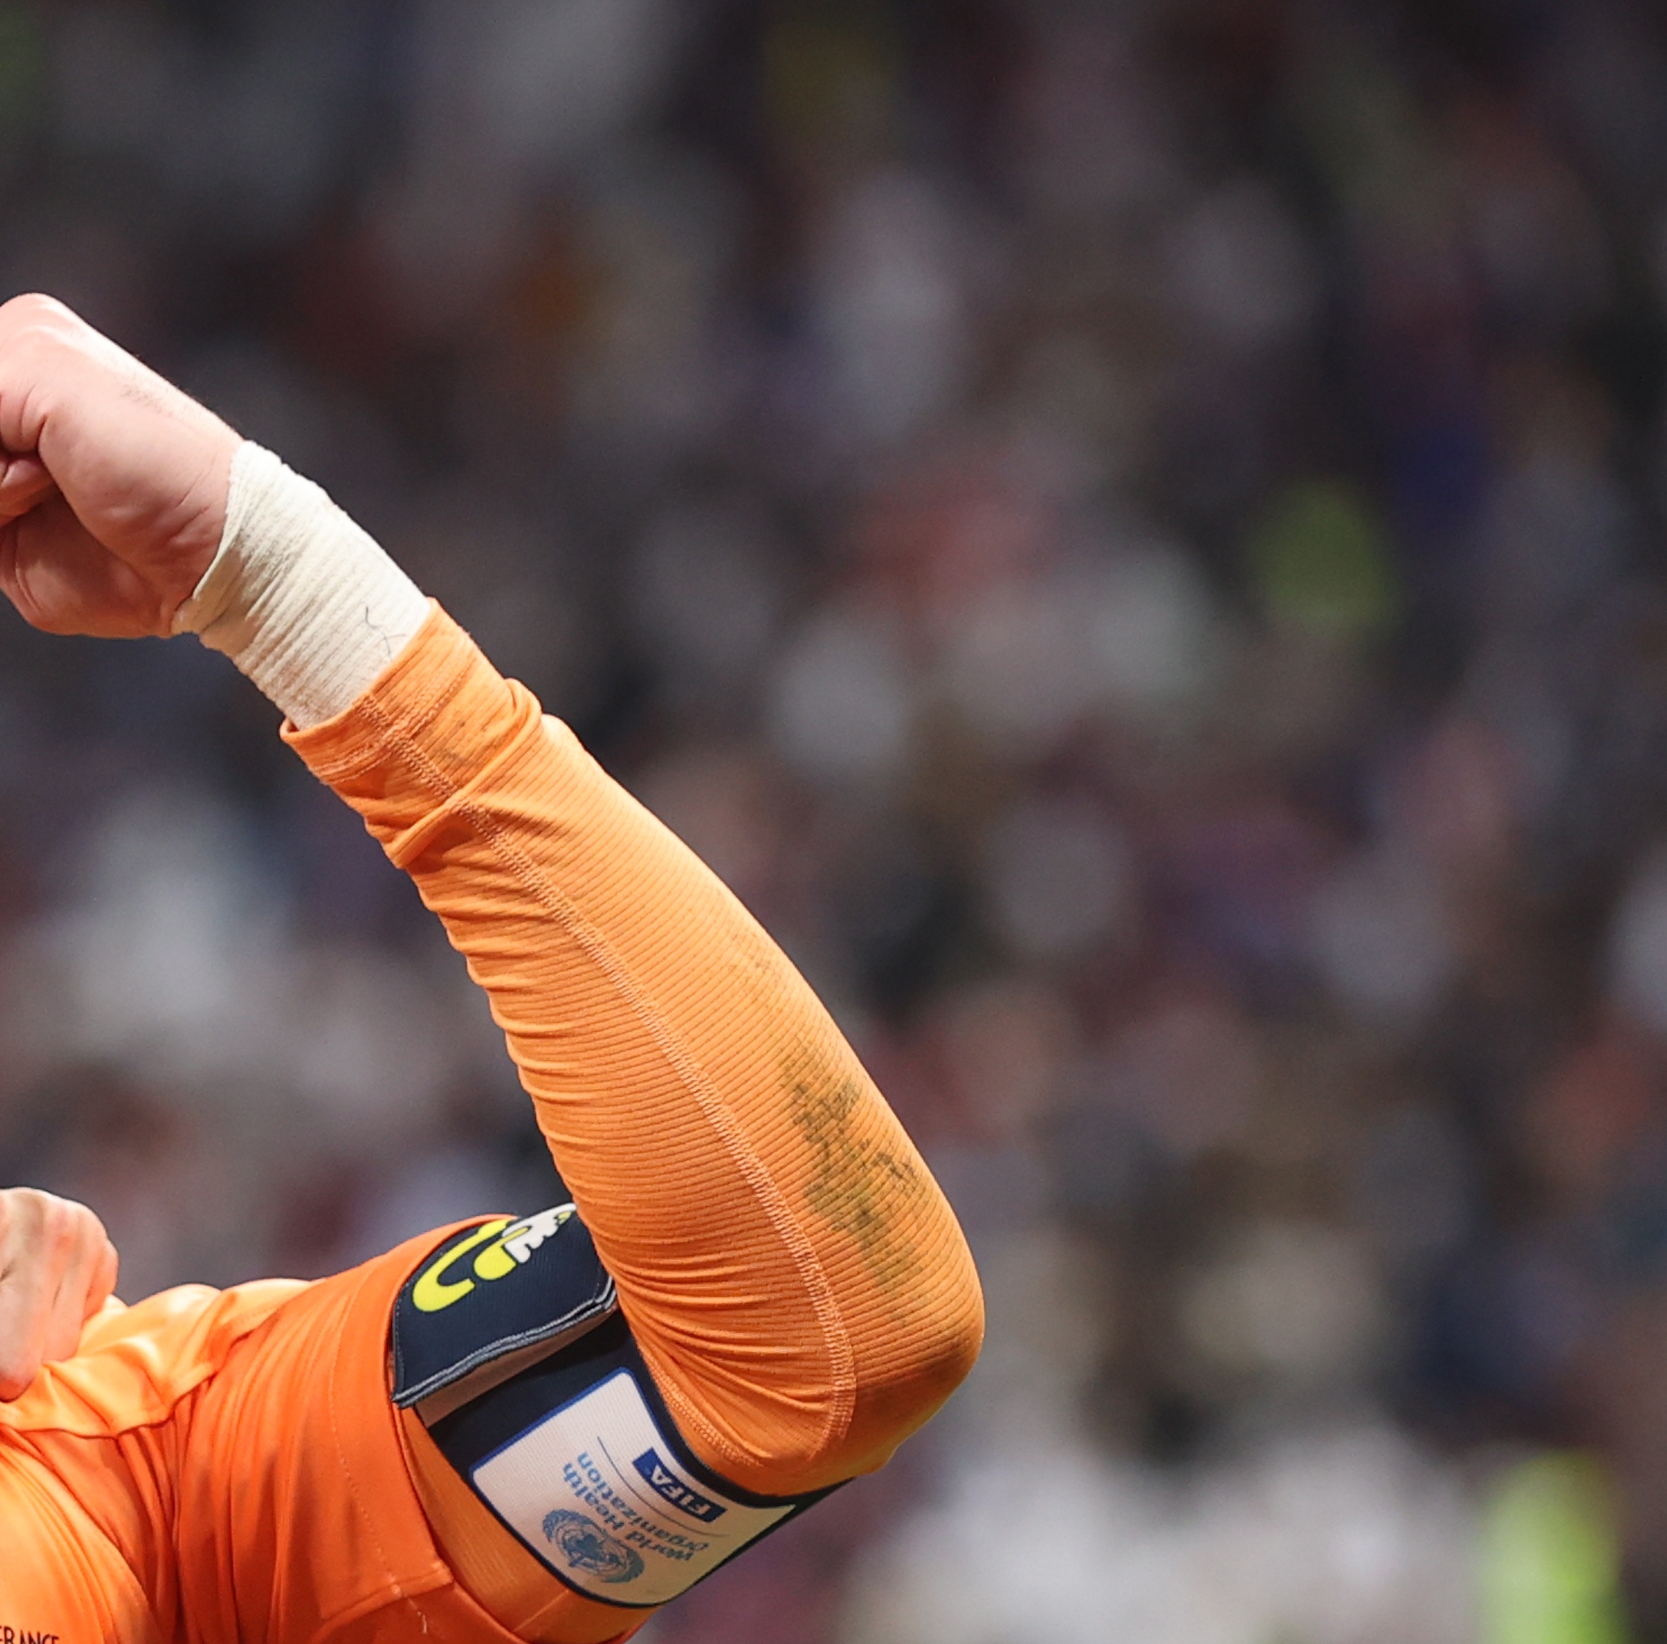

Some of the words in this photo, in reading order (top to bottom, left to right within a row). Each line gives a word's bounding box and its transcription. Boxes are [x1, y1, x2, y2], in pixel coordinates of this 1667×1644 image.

[563, 1463, 624, 1531] Health
[577, 1452, 709, 1552] Organization
[650, 1464, 713, 1517] FIFA
[625, 1530, 694, 1561] World
